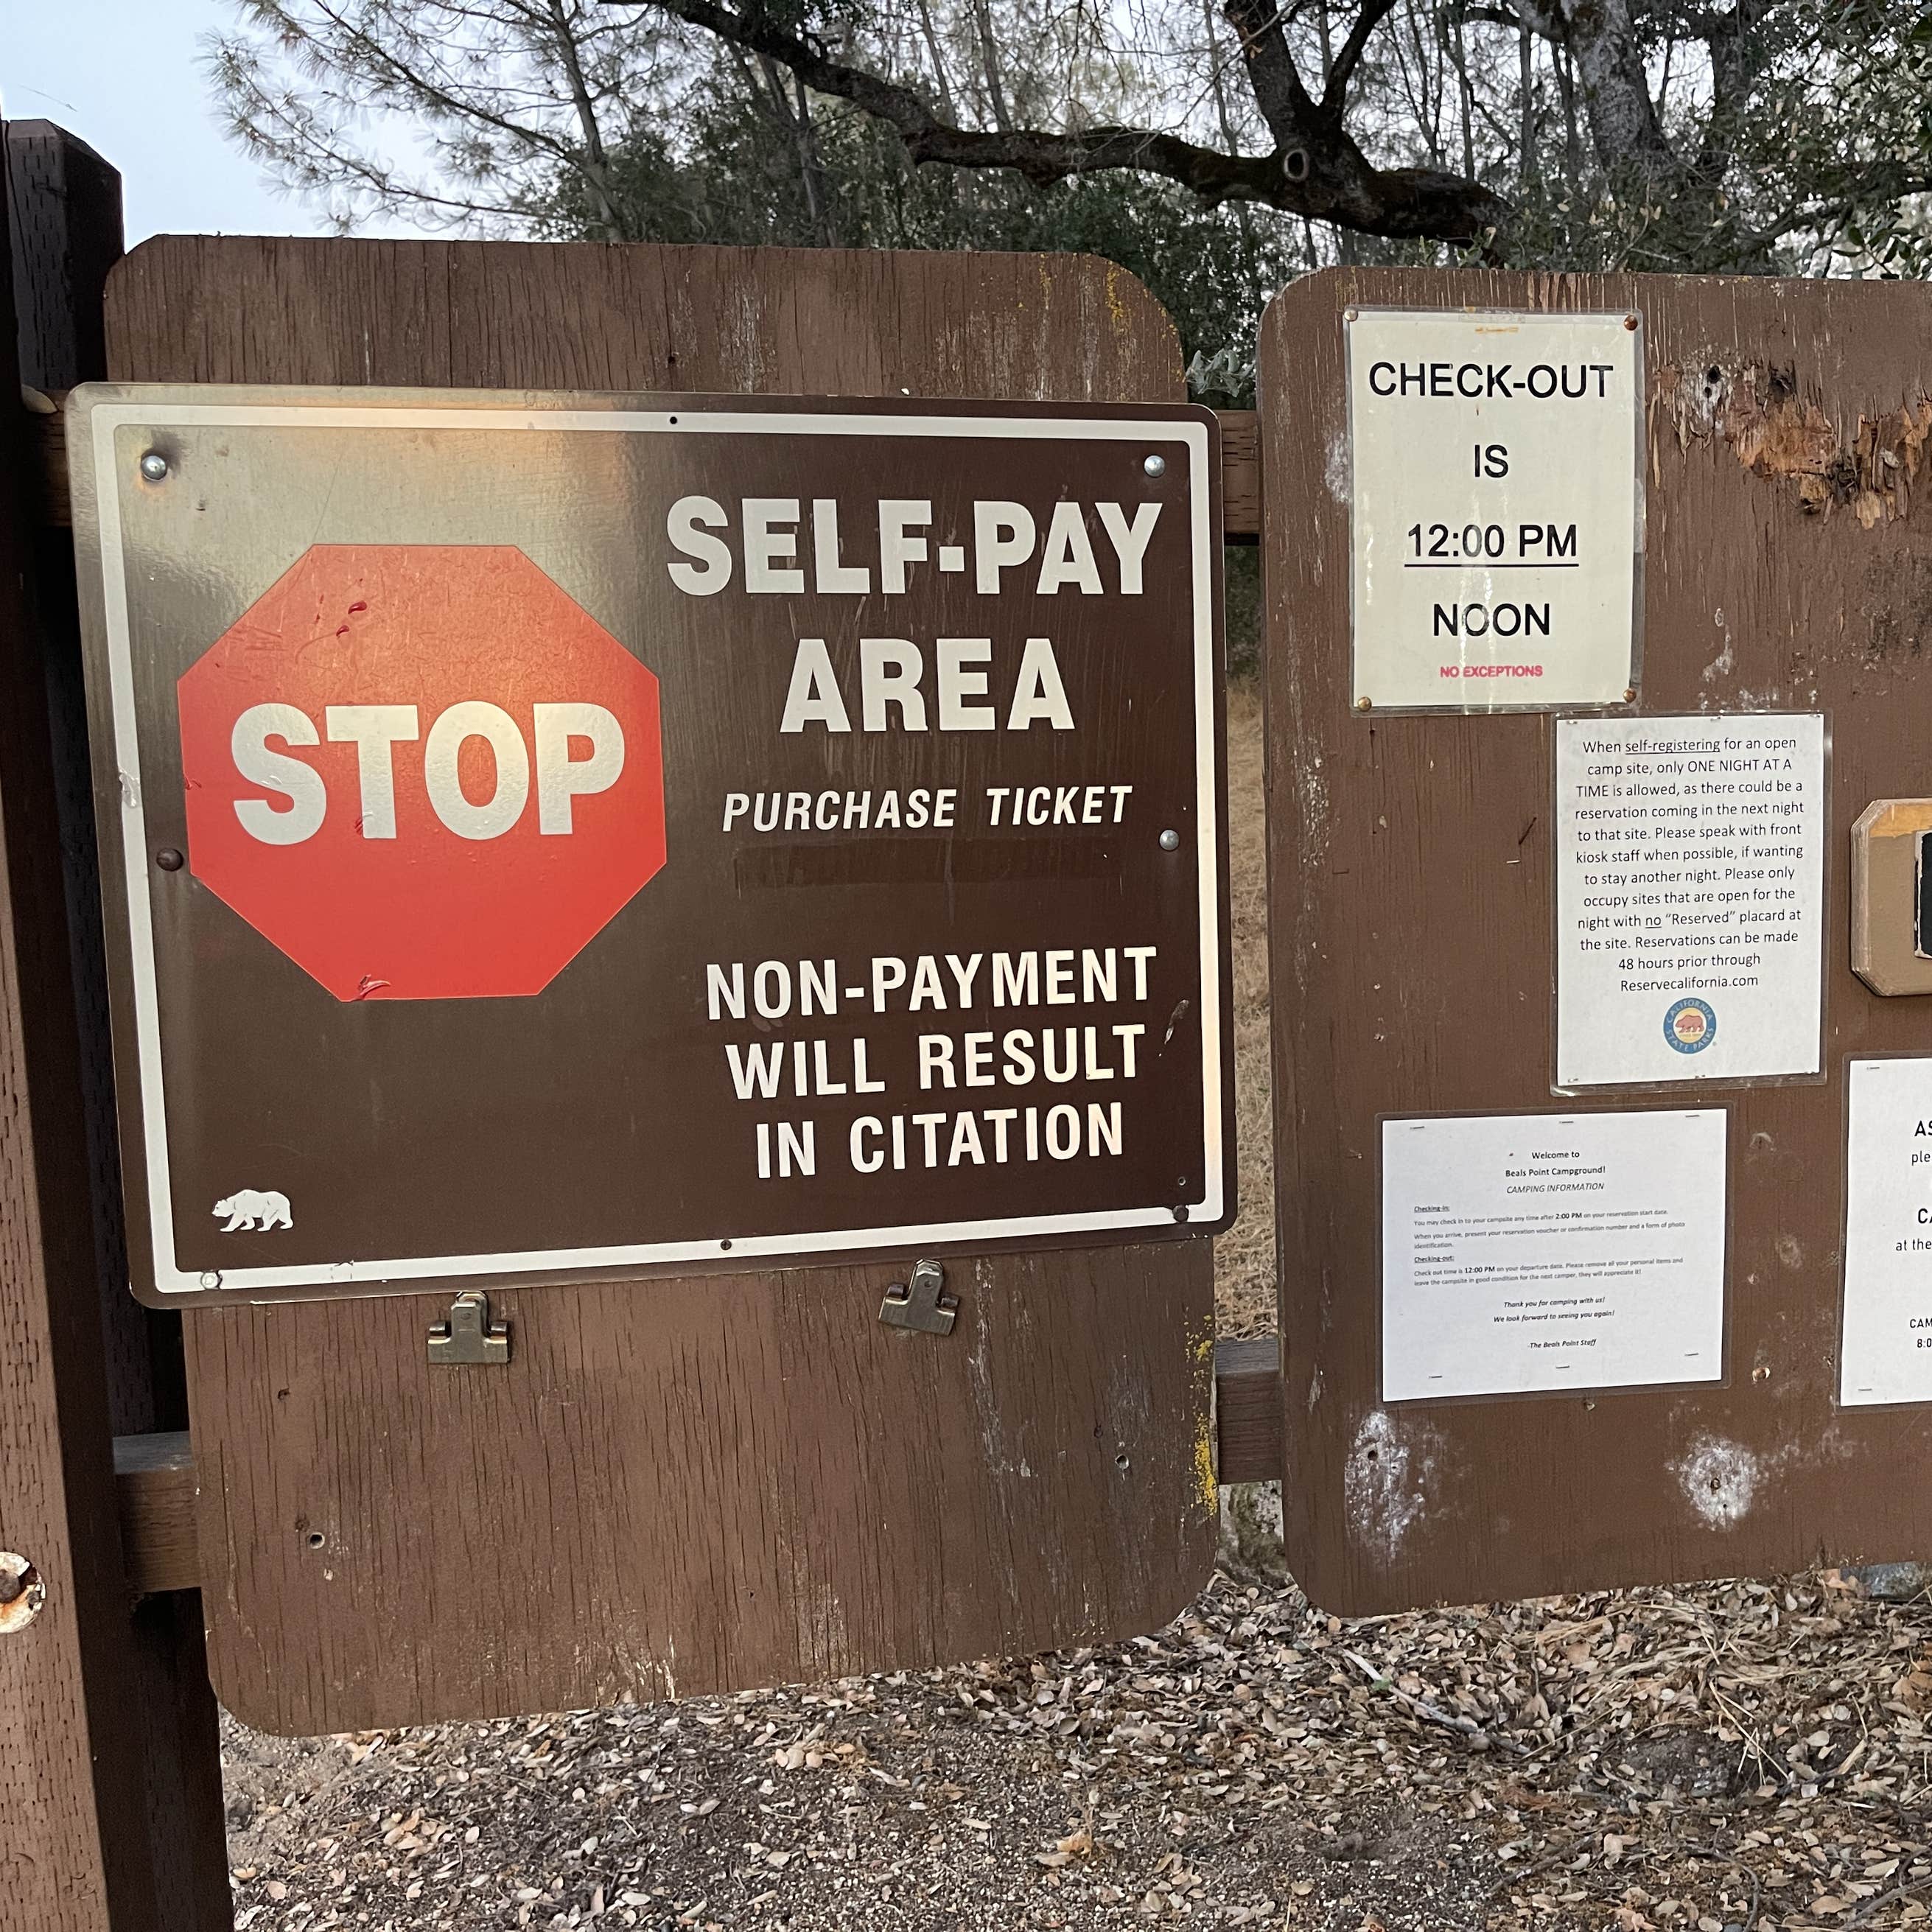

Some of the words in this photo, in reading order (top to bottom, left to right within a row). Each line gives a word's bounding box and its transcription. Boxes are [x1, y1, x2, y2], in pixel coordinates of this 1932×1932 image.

[1368, 361, 1614, 398] CHECK-OUT
[1474, 444, 1509, 477] IS
[667, 495, 1163, 596] SELF-PAY
[1407, 524, 1505, 558] 12:00
[1519, 524, 1577, 558] PM
[1433, 603, 1550, 637] NOON
[1440, 665, 1460, 678] NO
[1463, 665, 1543, 677] EXCEPTIONS
[780, 638, 1075, 732] AREA
[1582, 740, 1620, 753] When
[1624, 738, 1721, 755] self-registering
[1723, 737, 1742, 749] for
[1746, 740, 1760, 749] an
[1765, 739, 1796, 751] open
[231, 700, 625, 845] STOP
[1587, 765, 1622, 777] camp
[1626, 761, 1653, 775] site,
[1656, 760, 1684, 775] only
[1687, 760, 1715, 772] ONE
[1719, 759, 1760, 771] NIGHT
[1763, 758, 1779, 770] AT
[1782, 758, 1791, 770] A
[1575, 784, 1608, 797] TIME
[1612, 784, 1622, 796] is
[1625, 782, 1679, 797] allowed,
[1684, 785, 1697, 796] as
[1700, 781, 1735, 794] there
[1738, 779, 1771, 792] could
[1777, 779, 1791, 791] be
[1795, 782, 1802, 791] a
[722, 789, 957, 832] PURCHASE
[986, 785, 1133, 826] TICKET
[1575, 805, 1647, 819] reservation
[1651, 804, 1698, 819] coming
[1701, 803, 1712, 815] in
[1716, 802, 1737, 815] the
[1741, 802, 1768, 813] next
[1772, 800, 1804, 816] night
[1577, 830, 1590, 841] to
[1595, 828, 1620, 841] that
[1624, 827, 1651, 840] site.
[1655, 826, 1695, 839] Please
[1699, 824, 1735, 840] speak
[1738, 823, 1765, 836] with
[1770, 822, 1801, 835] front
[1576, 850, 1608, 863] kiosk
[1611, 848, 1640, 862] staff
[1643, 848, 1678, 861] when
[1683, 845, 1737, 863] possible,
[1741, 844, 1749, 858] if
[1752, 844, 1803, 858] wanting
[1583, 874, 1597, 885] to
[1600, 873, 1627, 886] stay
[1631, 869, 1681, 884] another
[1685, 868, 1721, 883] night.
[1725, 867, 1764, 879] Please
[1768, 865, 1794, 880] only
[1583, 896, 1628, 908] occupy
[1631, 892, 1660, 905] sites
[1664, 891, 1690, 903] that
[1693, 892, 1714, 902] are
[1718, 892, 1749, 904] open
[1753, 887, 1771, 900] for
[1774, 886, 1795, 900] the
[1578, 915, 1609, 931] night
[1613, 914, 1641, 927] with
[1644, 914, 1662, 928] no
[1740, 908, 1785, 925] placard
[1788, 909, 1801, 920] at
[1580, 938, 1600, 950] the
[1604, 937, 1631, 949] site.
[1635, 934, 1715, 948] Reservations
[1719, 934, 1740, 944] can
[1744, 931, 1760, 943] be
[1763, 929, 1798, 942] made
[1618, 958, 1633, 970] 48
[1637, 956, 1673, 969] hours
[1677, 955, 1707, 970] prior
[1711, 952, 1760, 967] through
[706, 946, 1157, 1021] NON-PAYMENT
[1620, 975, 1758, 992] Reservecalifornia.com
[725, 1037, 885, 1099] WILL
[919, 1024, 1145, 1090] RESULT
[755, 1121, 816, 1178] IN
[849, 1102, 1123, 1174] CITATION
[1531, 1151, 1569, 1159] Welcome
[1911, 1150, 1931, 1166] ple
[1505, 1169, 1526, 1177] Beals
[1528, 1168, 1550, 1176] Point
[1551, 1165, 1605, 1176] Campground!
[1506, 1184, 1545, 1193] CAMPING
[1547, 1182, 1604, 1191] INFORMATION
[1896, 1239, 1907, 1250] at
[1912, 1238, 1932, 1250] the
[1537, 1299, 1548, 1307] for
[1521, 1313, 1548, 1322] forward
[1593, 1309, 1614, 1318] again!
[1580, 1338, 1596, 1346] Staff
